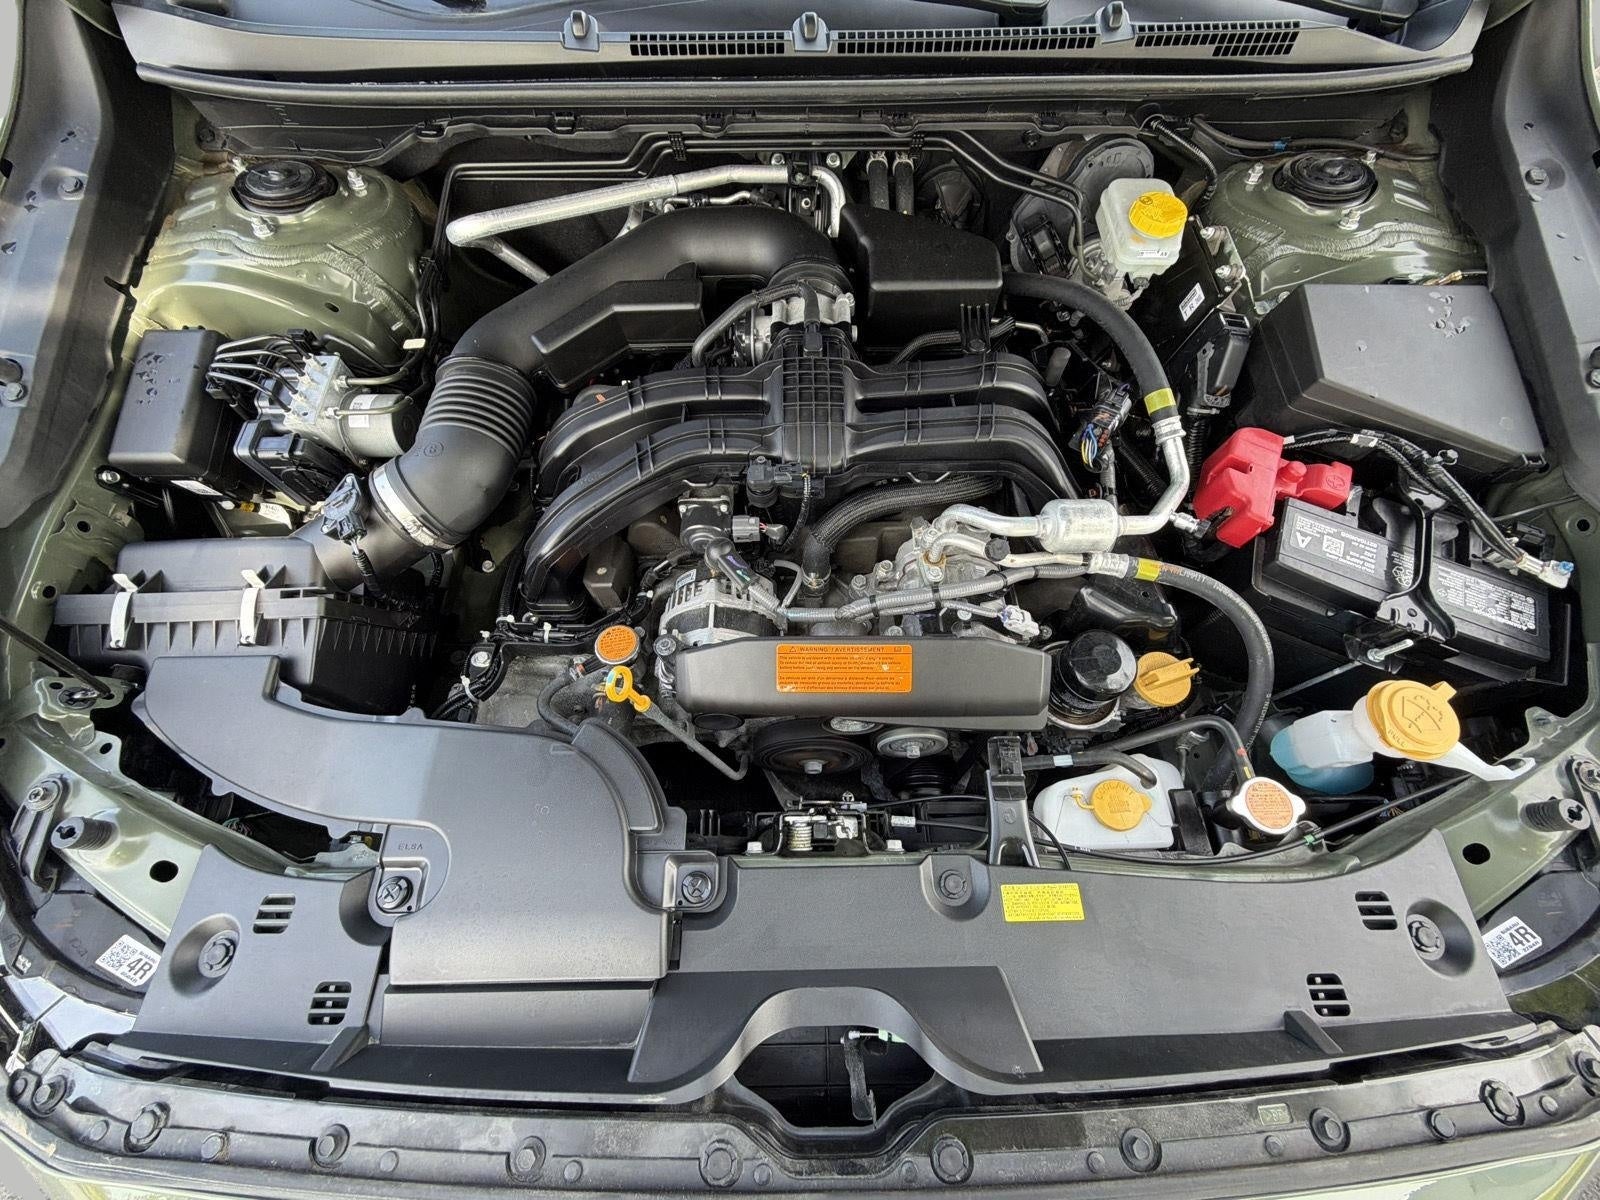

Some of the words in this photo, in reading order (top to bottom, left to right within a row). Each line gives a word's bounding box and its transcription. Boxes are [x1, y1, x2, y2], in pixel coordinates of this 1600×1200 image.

[1296, 531, 1312, 549] A
[1509, 926, 1537, 947] 4R
[126, 957, 153, 980] 4R
